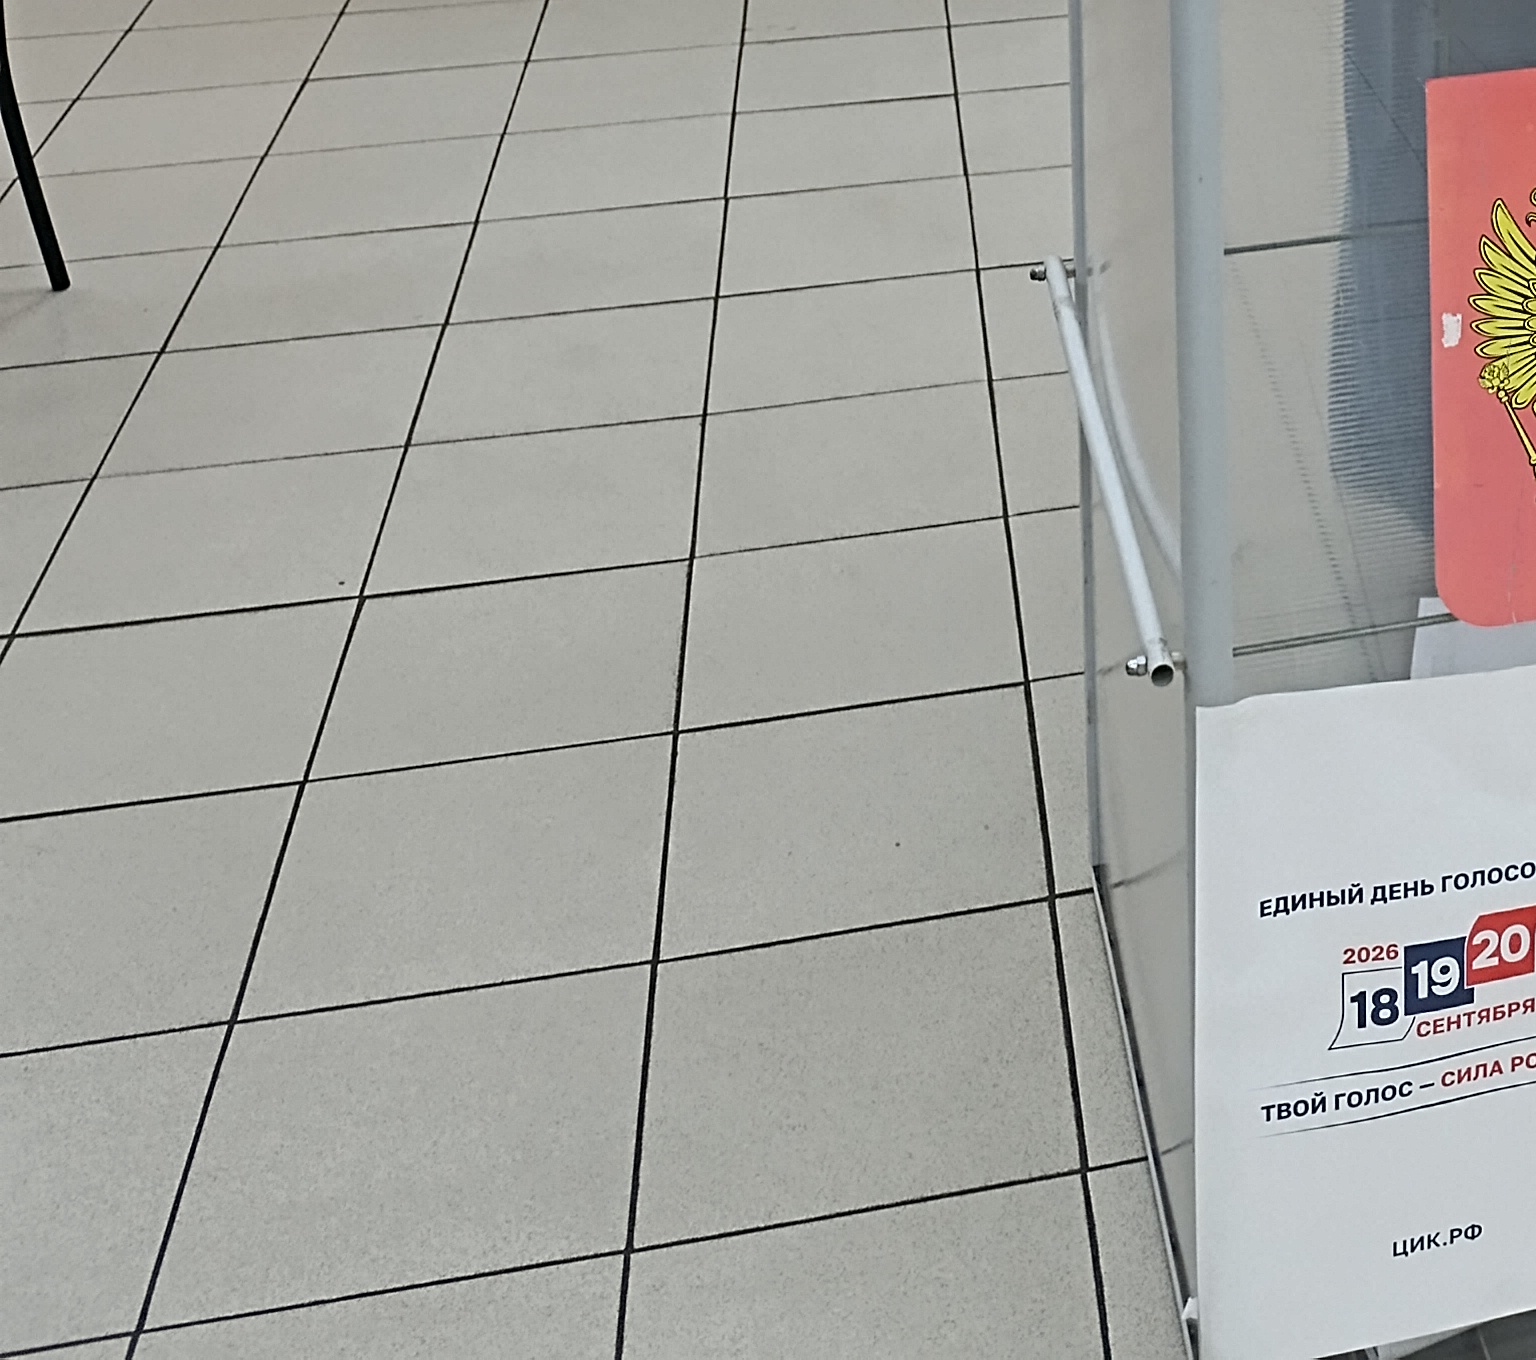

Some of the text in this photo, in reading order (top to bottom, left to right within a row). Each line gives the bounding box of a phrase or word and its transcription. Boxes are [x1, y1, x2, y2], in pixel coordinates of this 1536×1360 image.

[1259, 883, 1364, 917] ЕДИНЫЙ
[1371, 878, 1434, 905] ДЕНЬ
[1342, 943, 1398, 964] 2026
[1350, 923, 1530, 1028] 18 19 20
[1416, 997, 1535, 1038] СЕНТЯБРЯ
[1261, 1093, 1327, 1123] ТВОЙ
[1335, 1080, 1412, 1112] ГОЛОС
[1441, 1060, 1503, 1088] СИЛА
[1392, 1223, 1482, 1257] ЦИК.РФ
